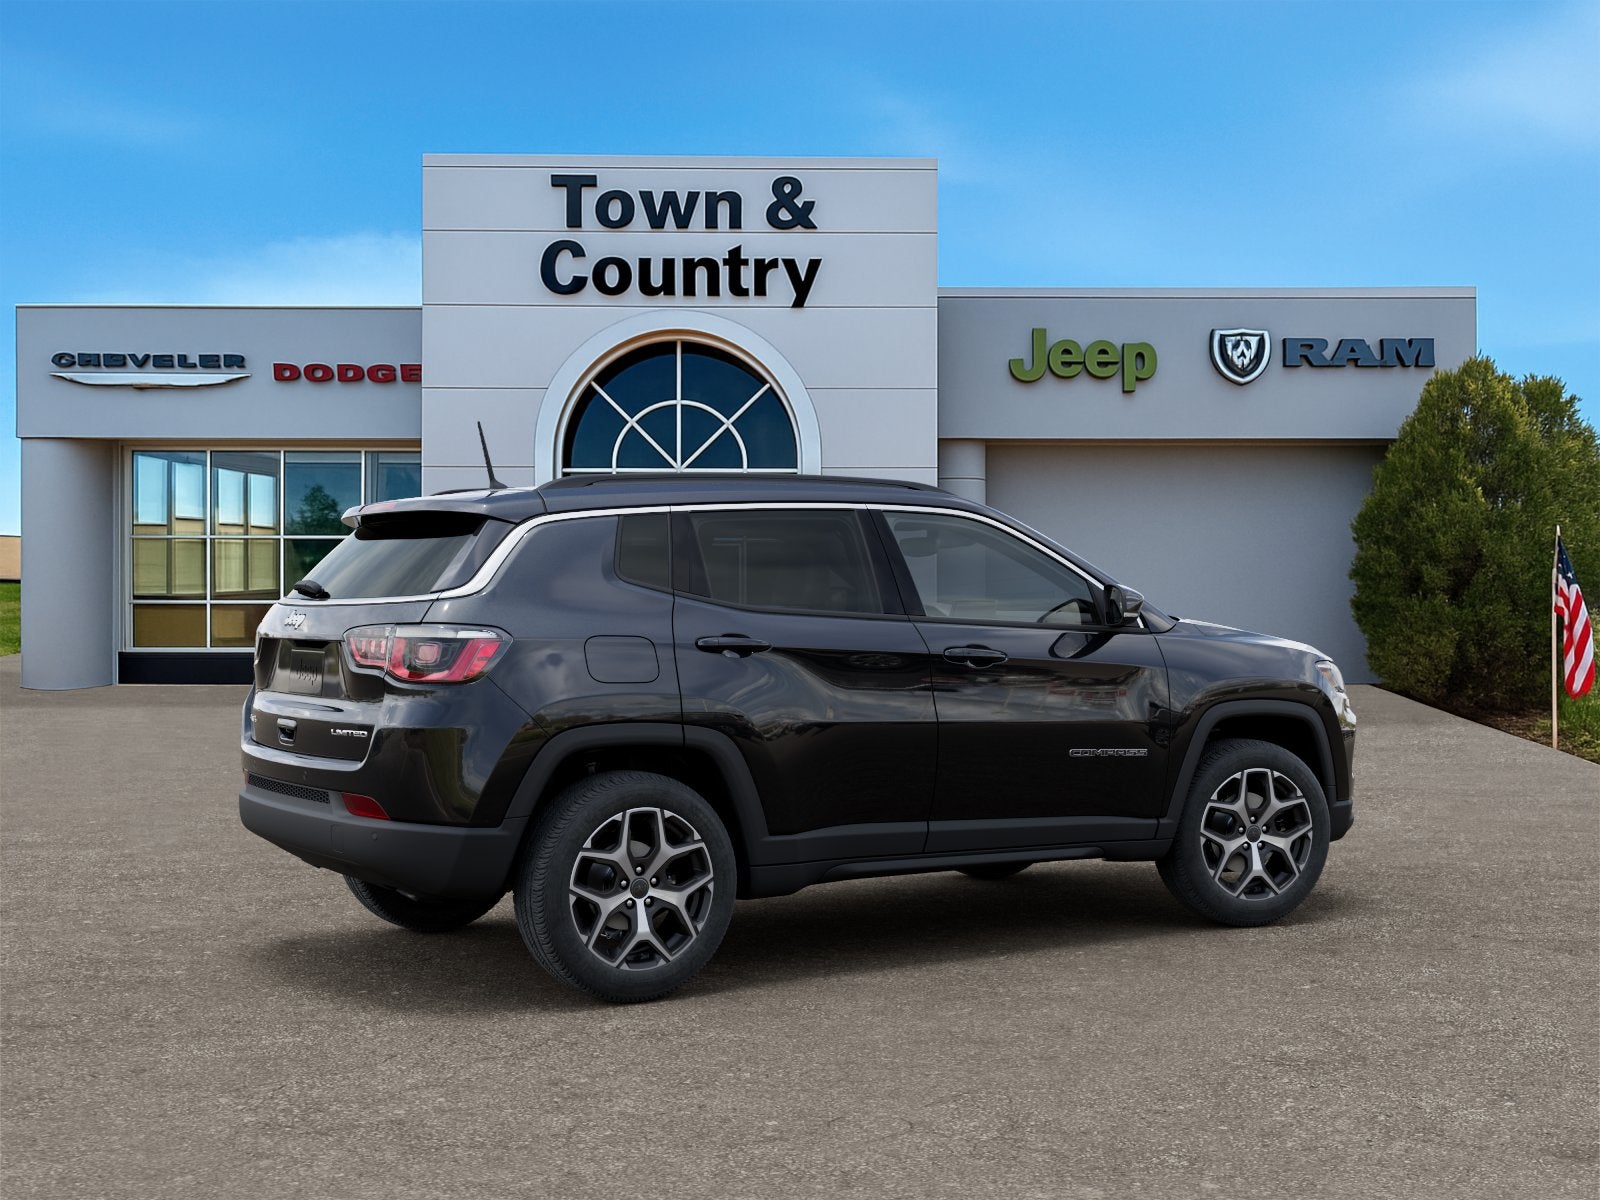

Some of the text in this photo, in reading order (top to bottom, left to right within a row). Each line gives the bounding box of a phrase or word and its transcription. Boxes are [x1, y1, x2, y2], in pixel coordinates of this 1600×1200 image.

[550, 174, 818, 230] Town &
[540, 239, 822, 308] Country
[1009, 327, 1158, 393] Jeep
[1282, 337, 1435, 368] RAM
[272, 363, 422, 383] DODGE
[330, 728, 368, 738] LIMITED
[1068, 748, 1149, 758] COMPASS
